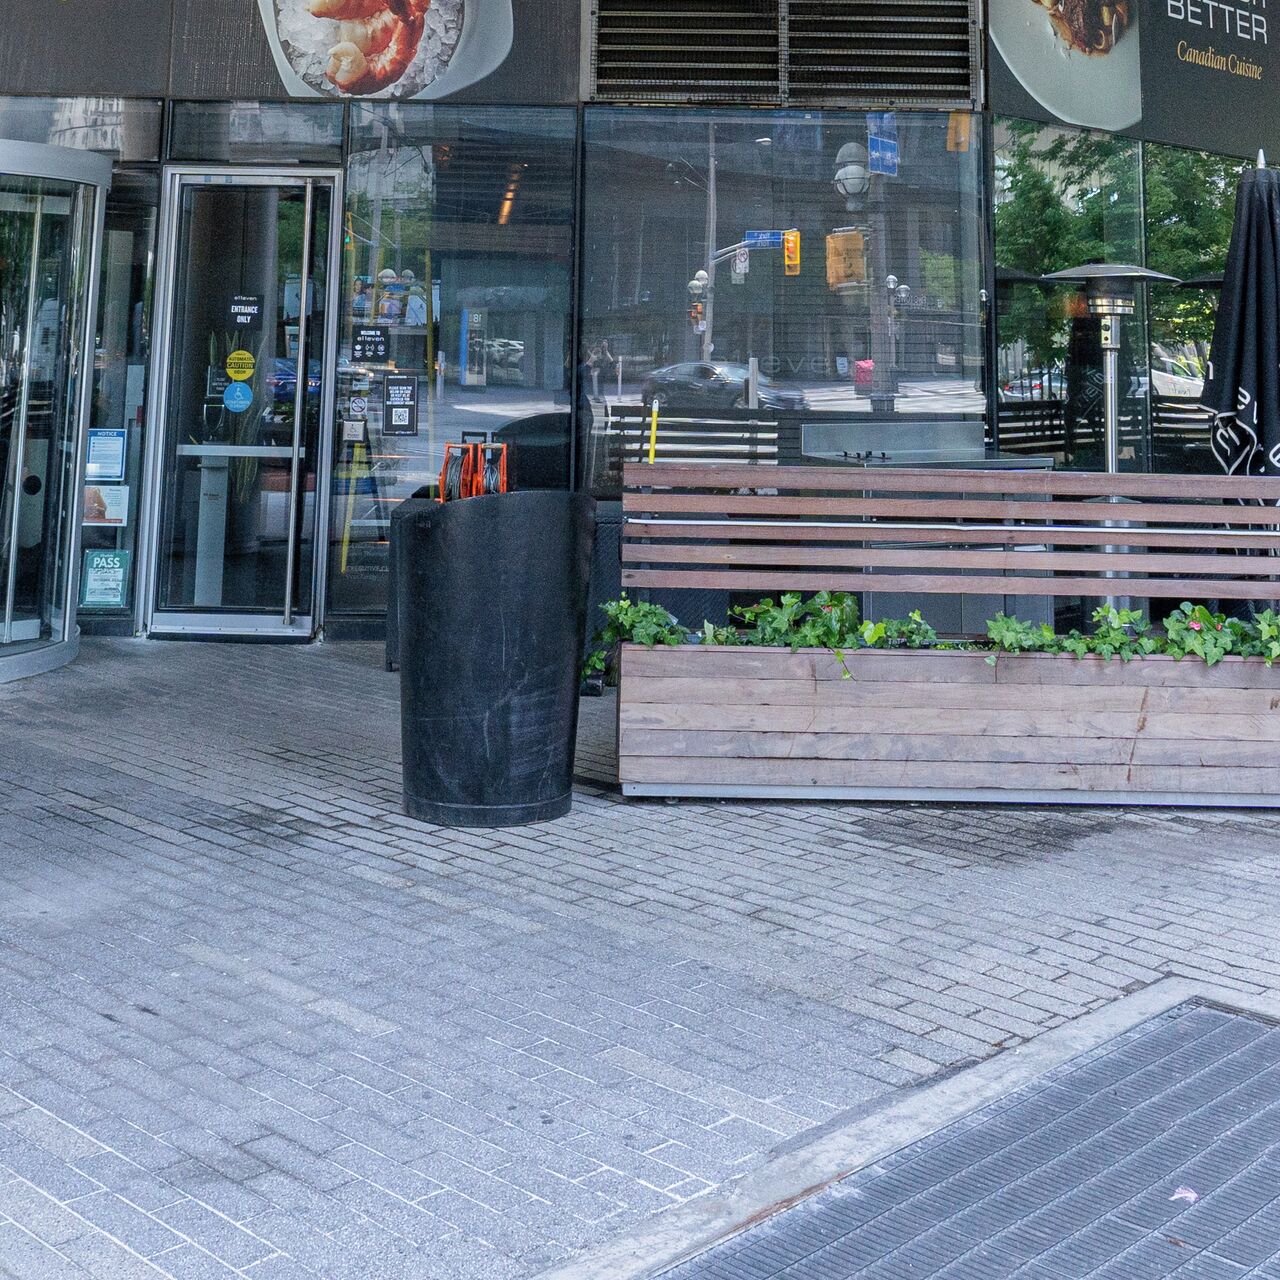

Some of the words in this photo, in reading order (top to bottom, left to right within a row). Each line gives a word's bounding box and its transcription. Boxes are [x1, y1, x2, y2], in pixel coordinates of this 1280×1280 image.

[1177, 39, 1227, 72] Canadian
[1227, 52, 1263, 80] Cuisine
[93, 557, 121, 568] PASS
